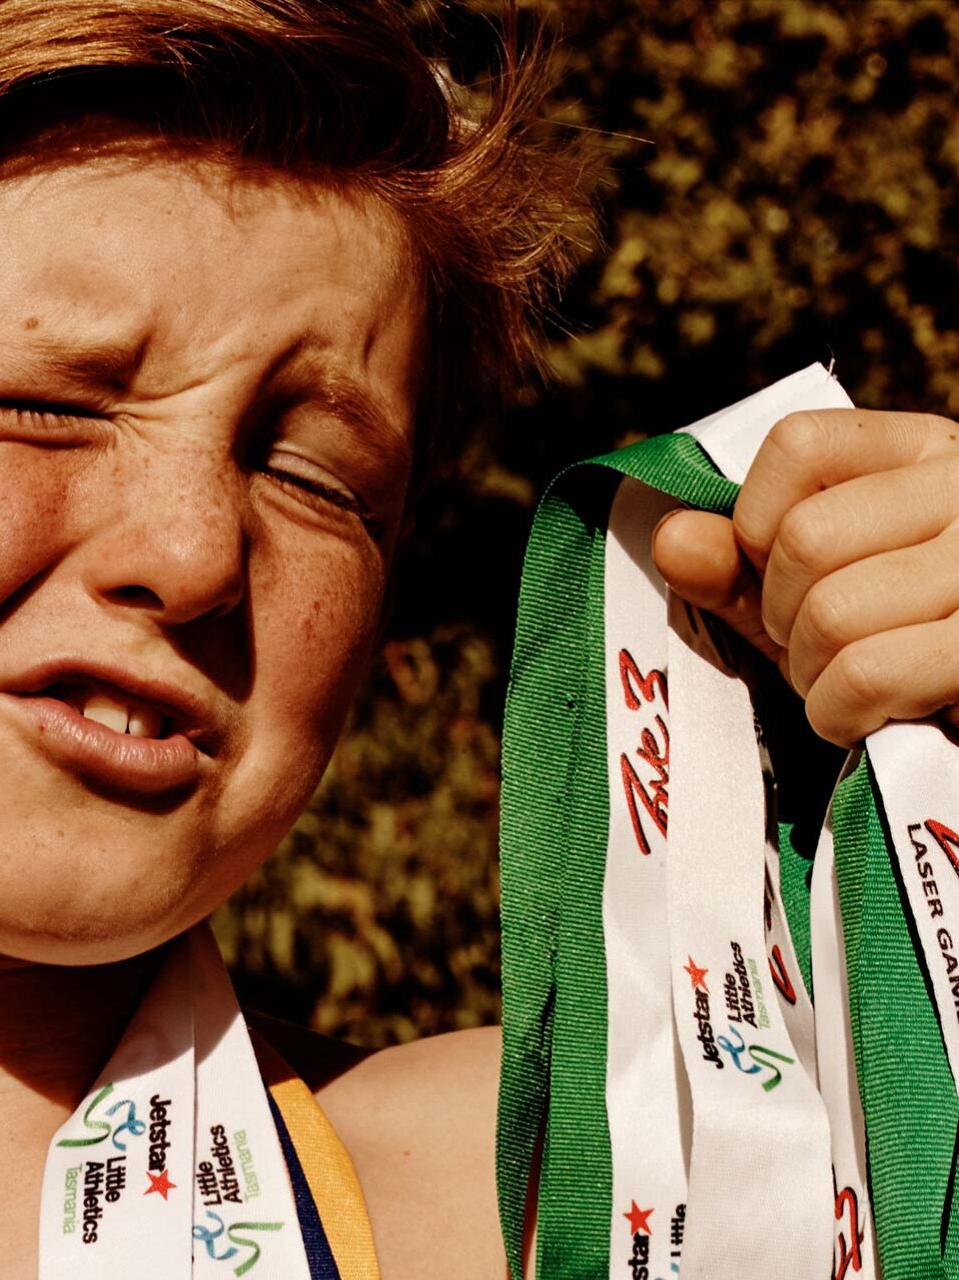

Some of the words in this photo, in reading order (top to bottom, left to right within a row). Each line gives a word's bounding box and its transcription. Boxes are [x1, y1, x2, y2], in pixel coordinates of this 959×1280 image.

[907, 823, 943, 919] LASER
[724, 973, 742, 1023] Little
[731, 941, 758, 1029] Athletics
[693, 987, 724, 1069] Jetstar
[148, 1094, 171, 1172] Jetstar
[210, 1124, 243, 1204] Athletics
[233, 1129, 260, 1202] Tasmania
[63, 1163, 82, 1235] Tasmania
[82, 1161, 105, 1245] Athletics
[105, 1156, 126, 1203] Little
[196, 1161, 222, 1207] Little
